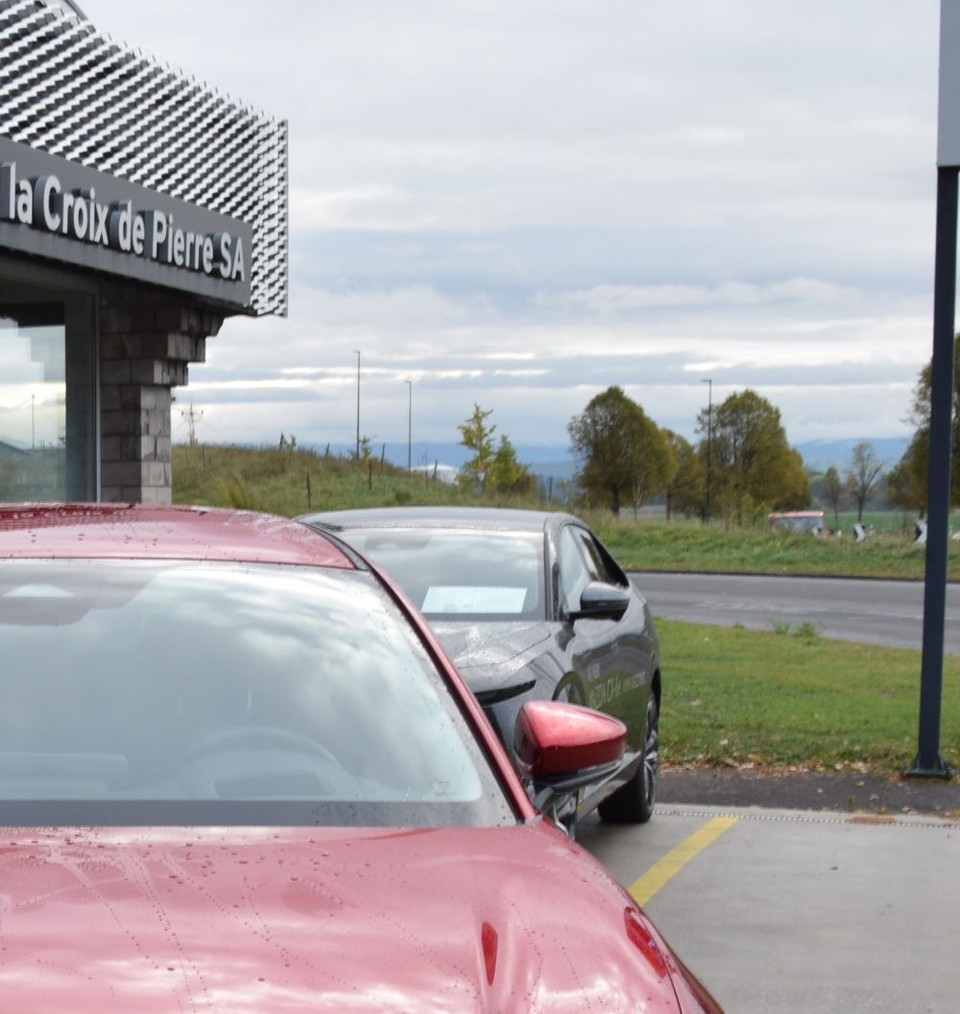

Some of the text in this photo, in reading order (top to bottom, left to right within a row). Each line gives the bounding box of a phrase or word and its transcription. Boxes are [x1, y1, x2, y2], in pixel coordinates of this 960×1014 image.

[5, 162, 33, 224] la
[41, 175, 109, 246] Croix
[116, 200, 145, 255] de
[150, 209, 215, 273] Pierre
[219, 231, 246, 282] SA
